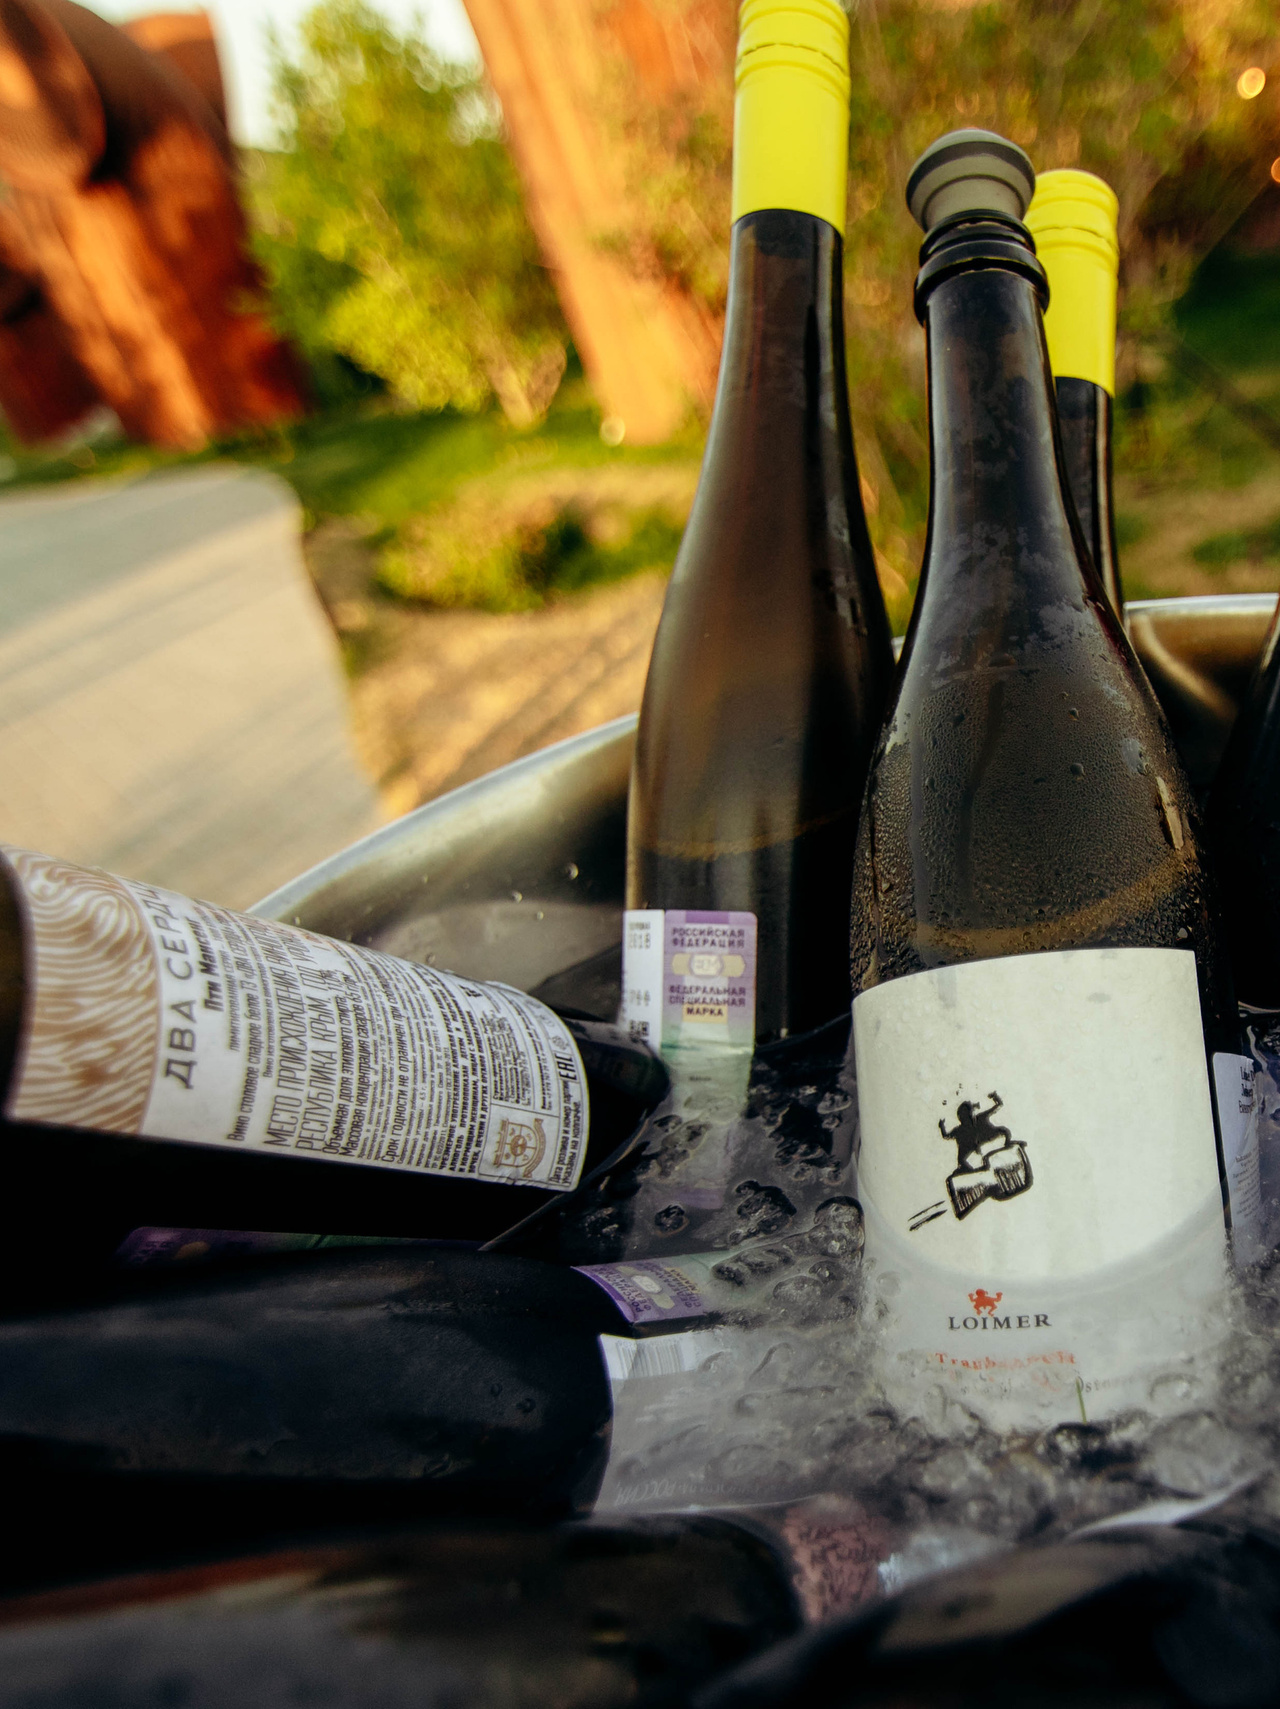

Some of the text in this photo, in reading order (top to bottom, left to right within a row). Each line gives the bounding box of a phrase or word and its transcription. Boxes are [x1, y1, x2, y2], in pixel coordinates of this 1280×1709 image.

[185, 916, 220, 977] Мансенг
[671, 926, 745, 938] РОССИЙСКАЯ
[672, 938, 745, 949] ФЕДЕРАЦИЯ
[296, 966, 328, 991] ГОД
[669, 984, 746, 996] ФЕДЕРАЛЬНАЯ
[203, 981, 224, 1012] Пти
[243, 993, 262, 1021] белое
[669, 995, 746, 1007] СПЕЦИАЛЬНАЯ
[686, 1007, 724, 1017] МАРКА
[306, 996, 337, 1043] КРЫМ.
[352, 1004, 371, 1039] сахаров
[390, 1005, 406, 1022] при
[164, 1000, 197, 1090] ДВА
[247, 1023, 264, 1065] сладкое
[262, 966, 308, 1147] МЕСТО ПРОИСХОЖДЕНИЯ
[340, 1027, 354, 1075] этилового
[394, 1023, 412, 1073] ограничен
[448, 1034, 460, 1069] АЛКОГОЛЯ
[458, 1037, 469, 1060] ДЕТЯМ
[262, 1058, 274, 1078] Вино
[355, 1039, 375, 1107] концентрация
[469, 1053, 478, 1077] ЛИЦАМ
[479, 1054, 488, 1084] ОРГАНОВ
[239, 1066, 260, 1114] столовое
[339, 1077, 354, 1102] доля
[398, 1075, 409, 1088] не
[450, 1070, 460, 1123] УПОТРЕБЛЕНИЕ
[459, 1065, 470, 1128] ПРОТИВОПОКАЗАН
[295, 1051, 337, 1151] РЕСПУБЛИКА
[391, 1090, 408, 1136] годности
[469, 1079, 480, 1123] ЖЕНЩИНАМ,
[480, 1085, 489, 1113] ДРУГИХ
[227, 1115, 251, 1141] Вино
[322, 1103, 349, 1155] Объемная
[339, 1109, 365, 1157] Массовая
[562, 1106, 572, 1129] номер
[381, 1138, 400, 1162] Срок
[439, 1124, 456, 1170] ЧРЕЗМЕРНОЕ
[459, 1124, 476, 1167] КОРМЯЩИМ
[475, 1121, 487, 1148] ПЕЧЕНИ
[448, 1135, 465, 1172] АЛКОГОЛЬ
[556, 1136, 570, 1166] розлива
[561, 1151, 577, 1185] указаны
[570, 1140, 579, 1150] на
[549, 1166, 563, 1184] Дата
[948, 1313, 1052, 1330] LOIMER
